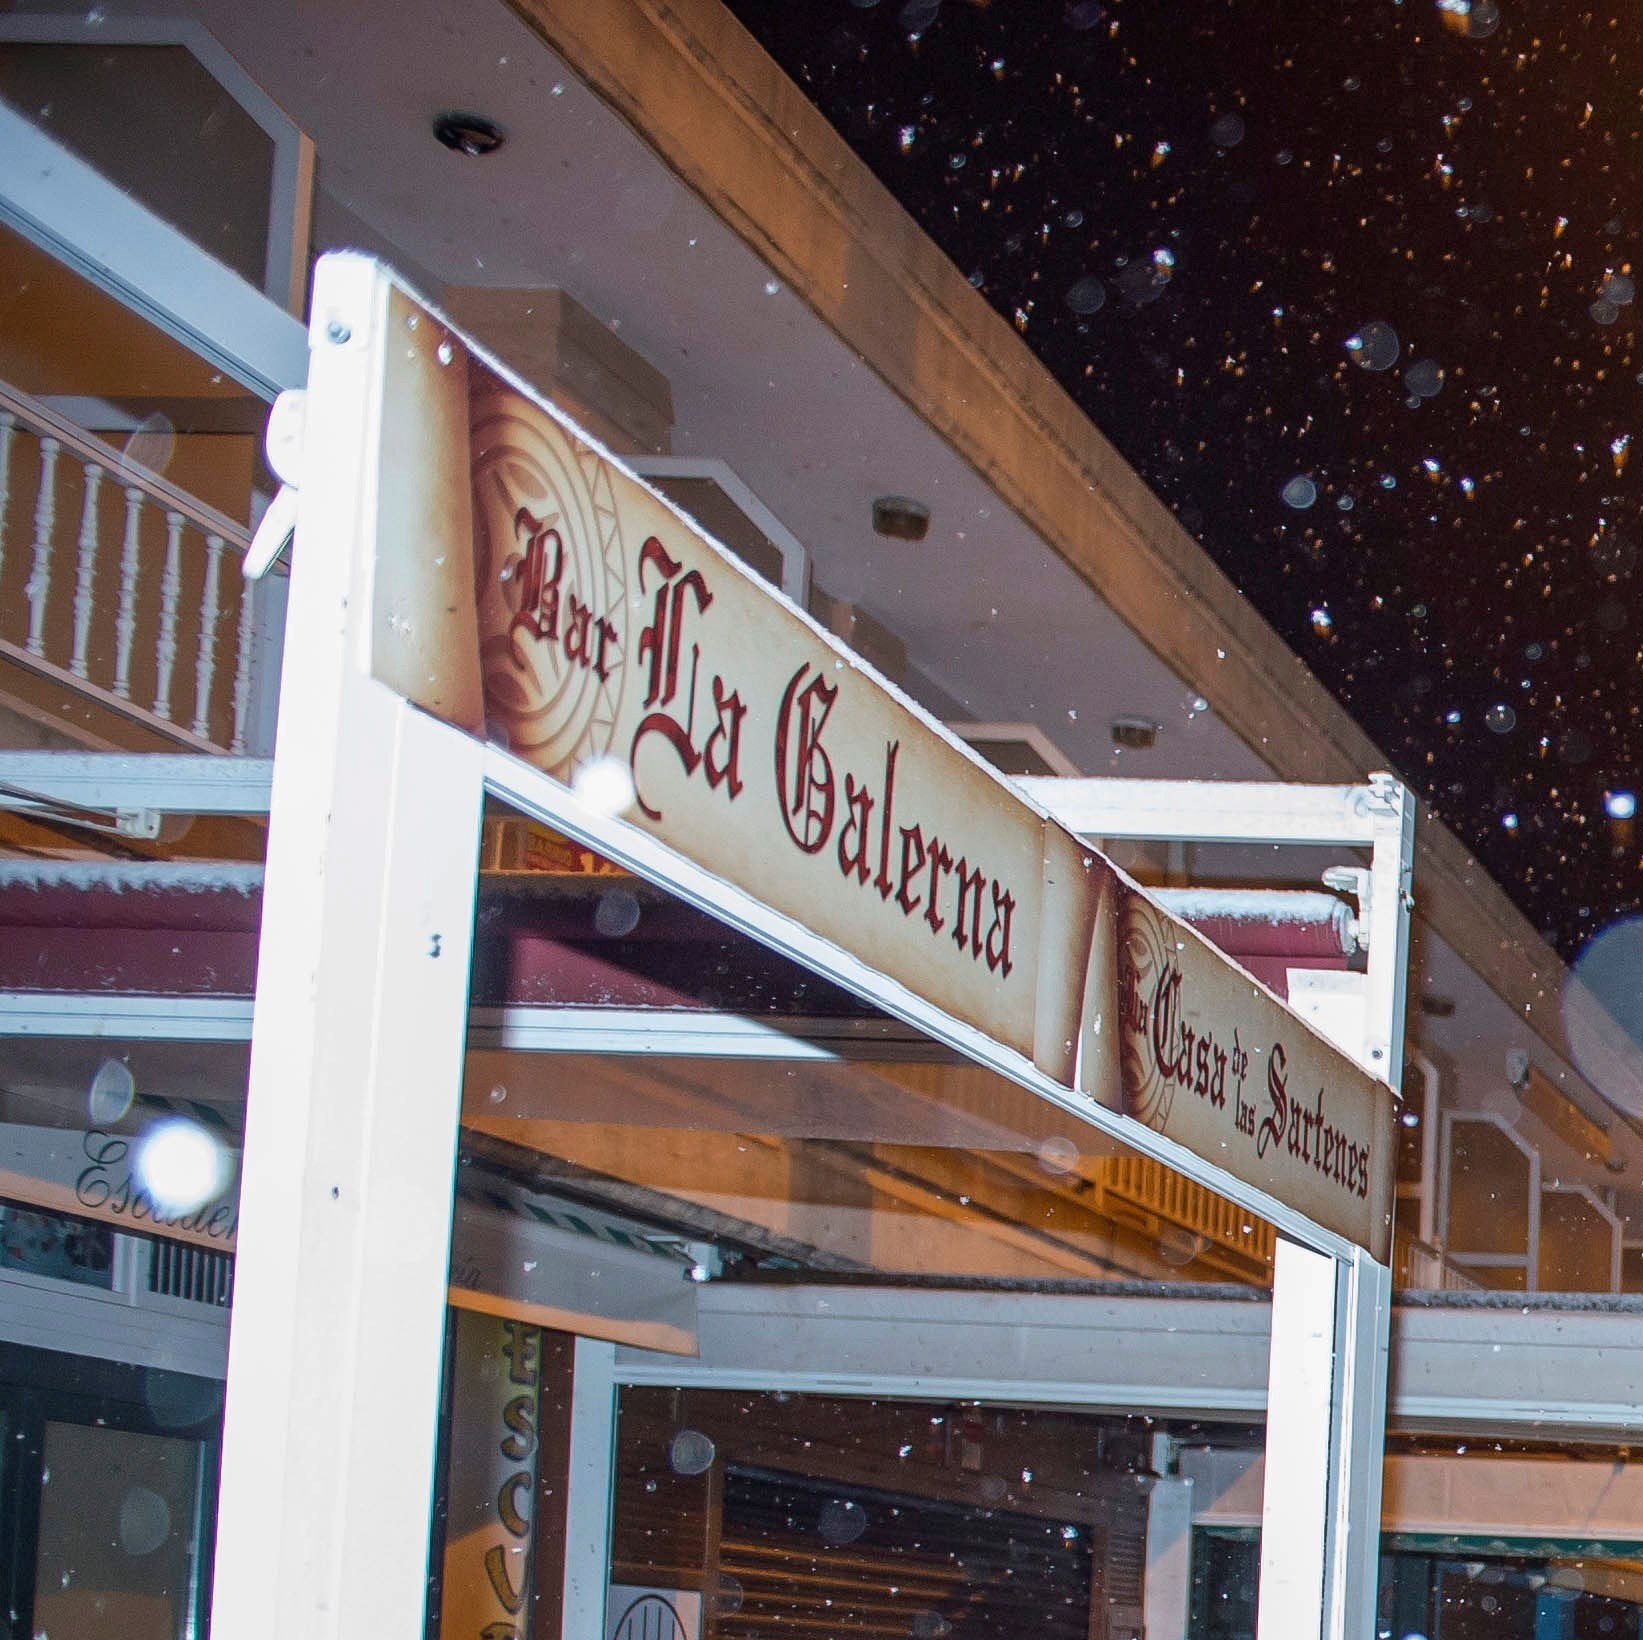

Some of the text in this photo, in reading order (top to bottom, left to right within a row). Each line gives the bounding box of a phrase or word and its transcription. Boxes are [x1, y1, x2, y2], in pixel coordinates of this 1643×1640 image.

[509, 506, 1016, 979] Bar La Galerna
[1124, 962, 1371, 1200] La Casa de las Sartenes
